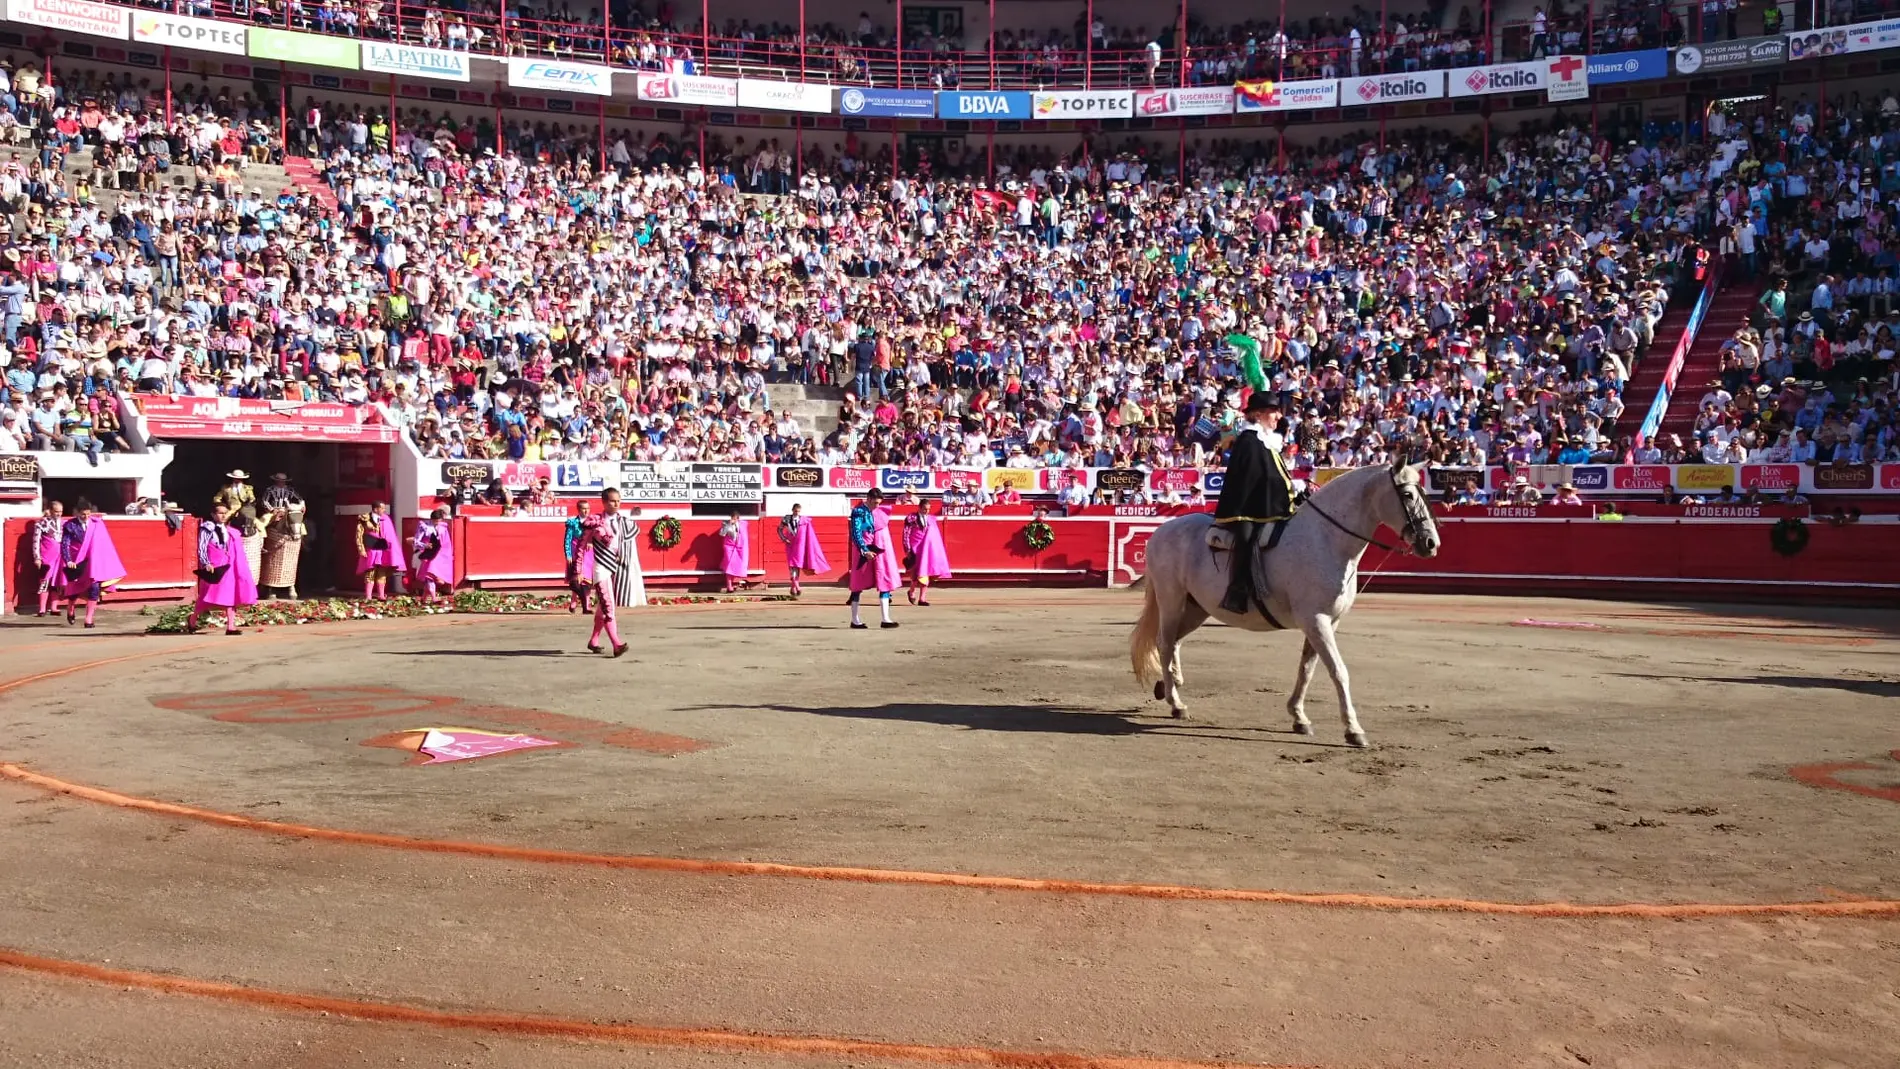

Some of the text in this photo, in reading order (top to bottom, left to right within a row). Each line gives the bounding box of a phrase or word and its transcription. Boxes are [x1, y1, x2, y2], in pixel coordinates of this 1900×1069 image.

[36, 0, 119, 22] KENWORTH
[18, 10, 33, 20] DE
[38, 14, 53, 24] LA
[164, 23, 244, 45] TOPTEC
[371, 46, 393, 60] LA
[398, 50, 462, 69] PATRIA
[1587, 63, 1624, 74] Allianz
[525, 64, 599, 86] Fenix
[1488, 70, 1537, 88] italia
[1283, 85, 1334, 96] Comercial
[1379, 79, 1427, 97] italia
[1292, 94, 1323, 103] Caldas
[960, 95, 1009, 114] BBVA
[1061, 98, 1128, 111] TOPTEC
[694, 473, 757, 484] S. CASTELLA
[836, 478, 871, 488] CALDAS
[886, 475, 925, 486] Cristal
[1622, 478, 1663, 489] CALDAS
[623, 489, 634, 498] 34
[671, 490, 688, 498] 454
[697, 490, 757, 499] LAS VENTAS
[1115, 507, 1157, 515] MEDICOS
[1486, 507, 1537, 517] TOREROS
[1684, 506, 1760, 517] APODERADOS
